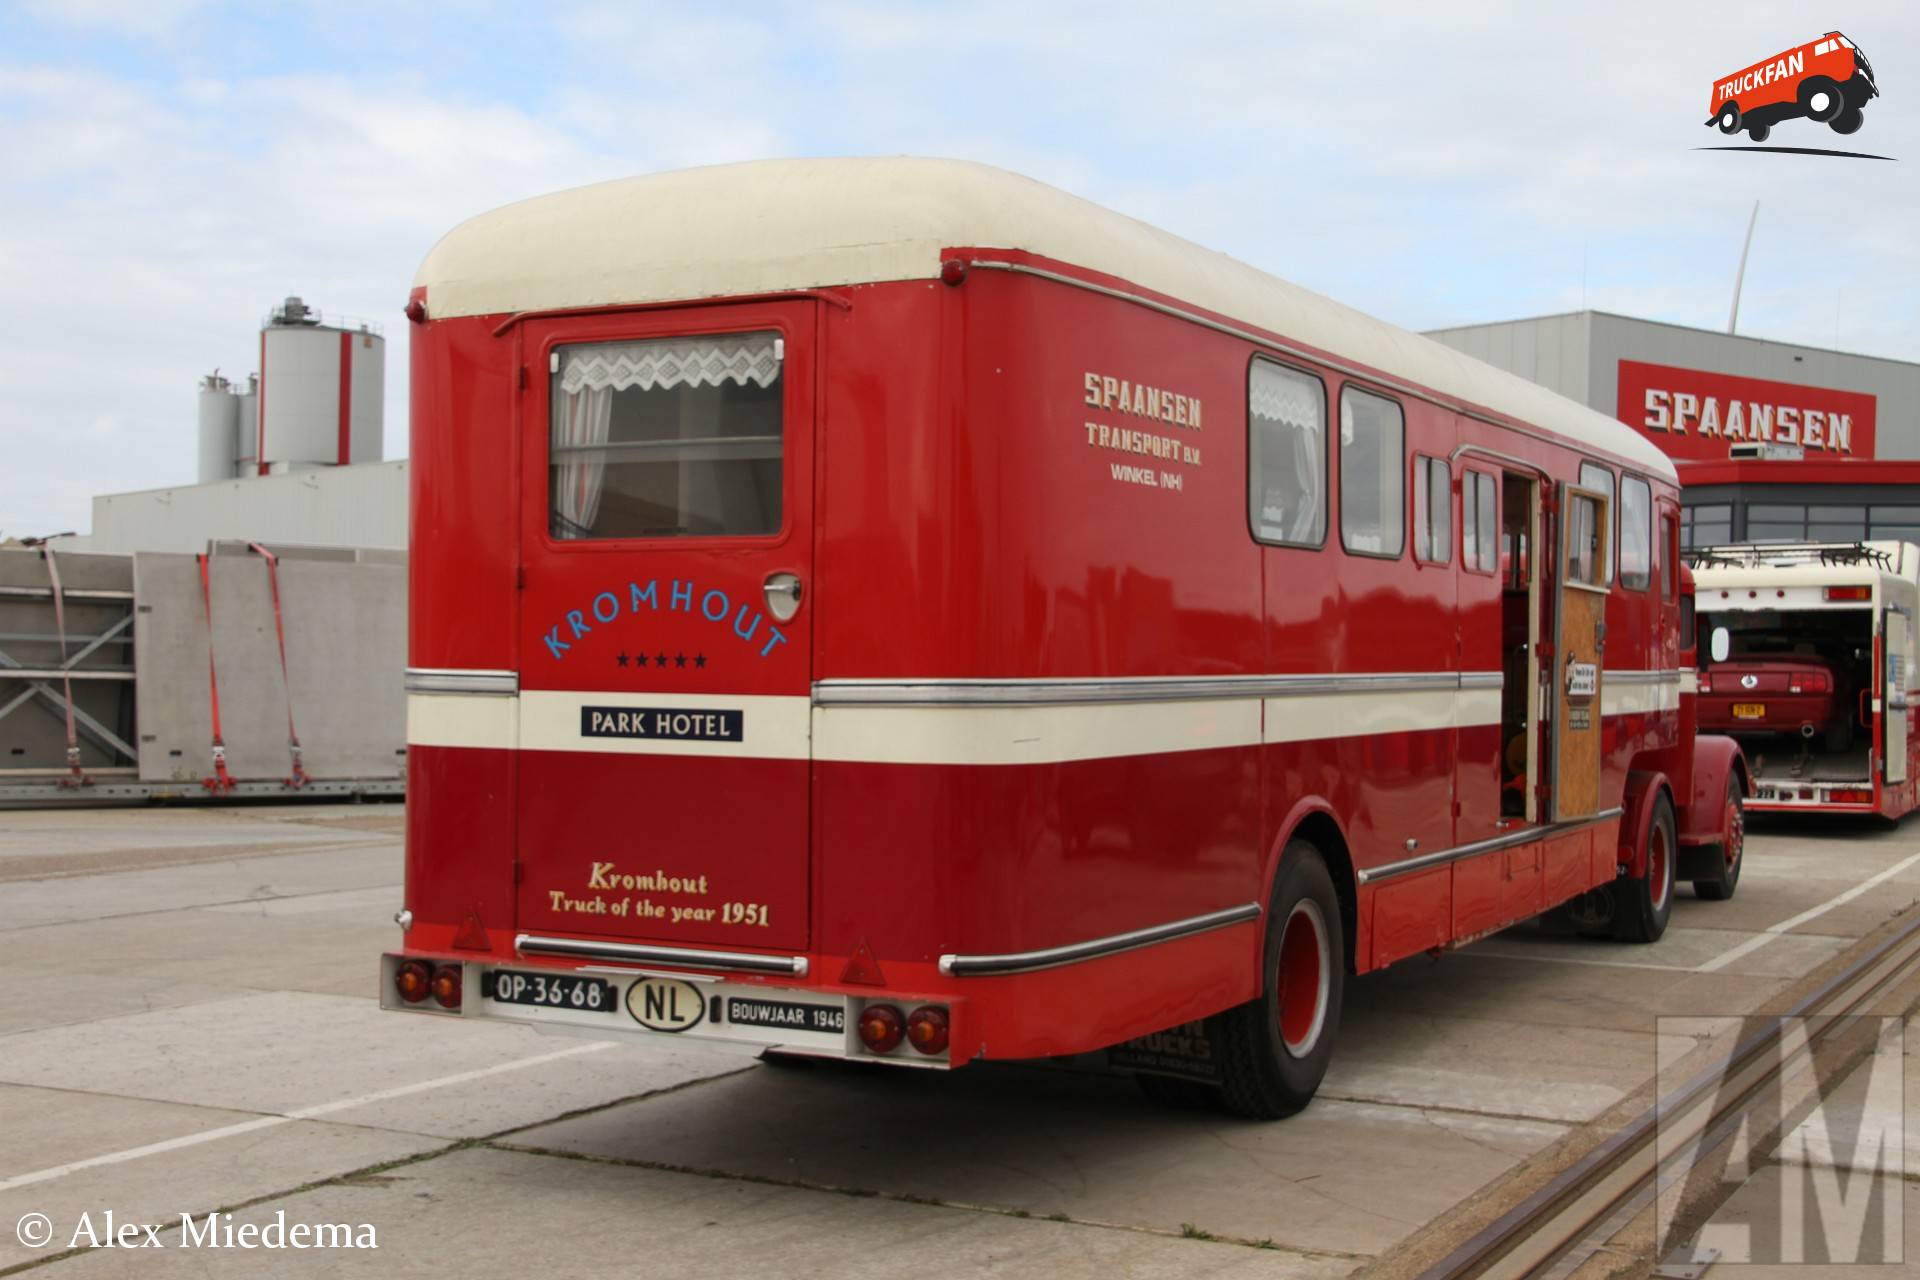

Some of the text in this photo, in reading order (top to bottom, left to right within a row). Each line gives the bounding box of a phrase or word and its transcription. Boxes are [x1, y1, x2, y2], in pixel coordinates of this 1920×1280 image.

[1084, 372, 1201, 430] SPAANSEN
[1644, 388, 1853, 453] SPAANSEN
[1084, 422, 1181, 463] TRANSPORT
[1110, 463, 1158, 487] WINKEL
[543, 580, 788, 660] KROMHOUT
[591, 711, 731, 737] PARK HOTEL
[588, 862, 708, 894] Kromhout
[549, 890, 769, 928] Truck of the year 1951
[497, 974, 602, 1009] OP-36-68
[645, 983, 685, 1022] NL
[731, 1003, 844, 1029] BOUWJAAR 1946
